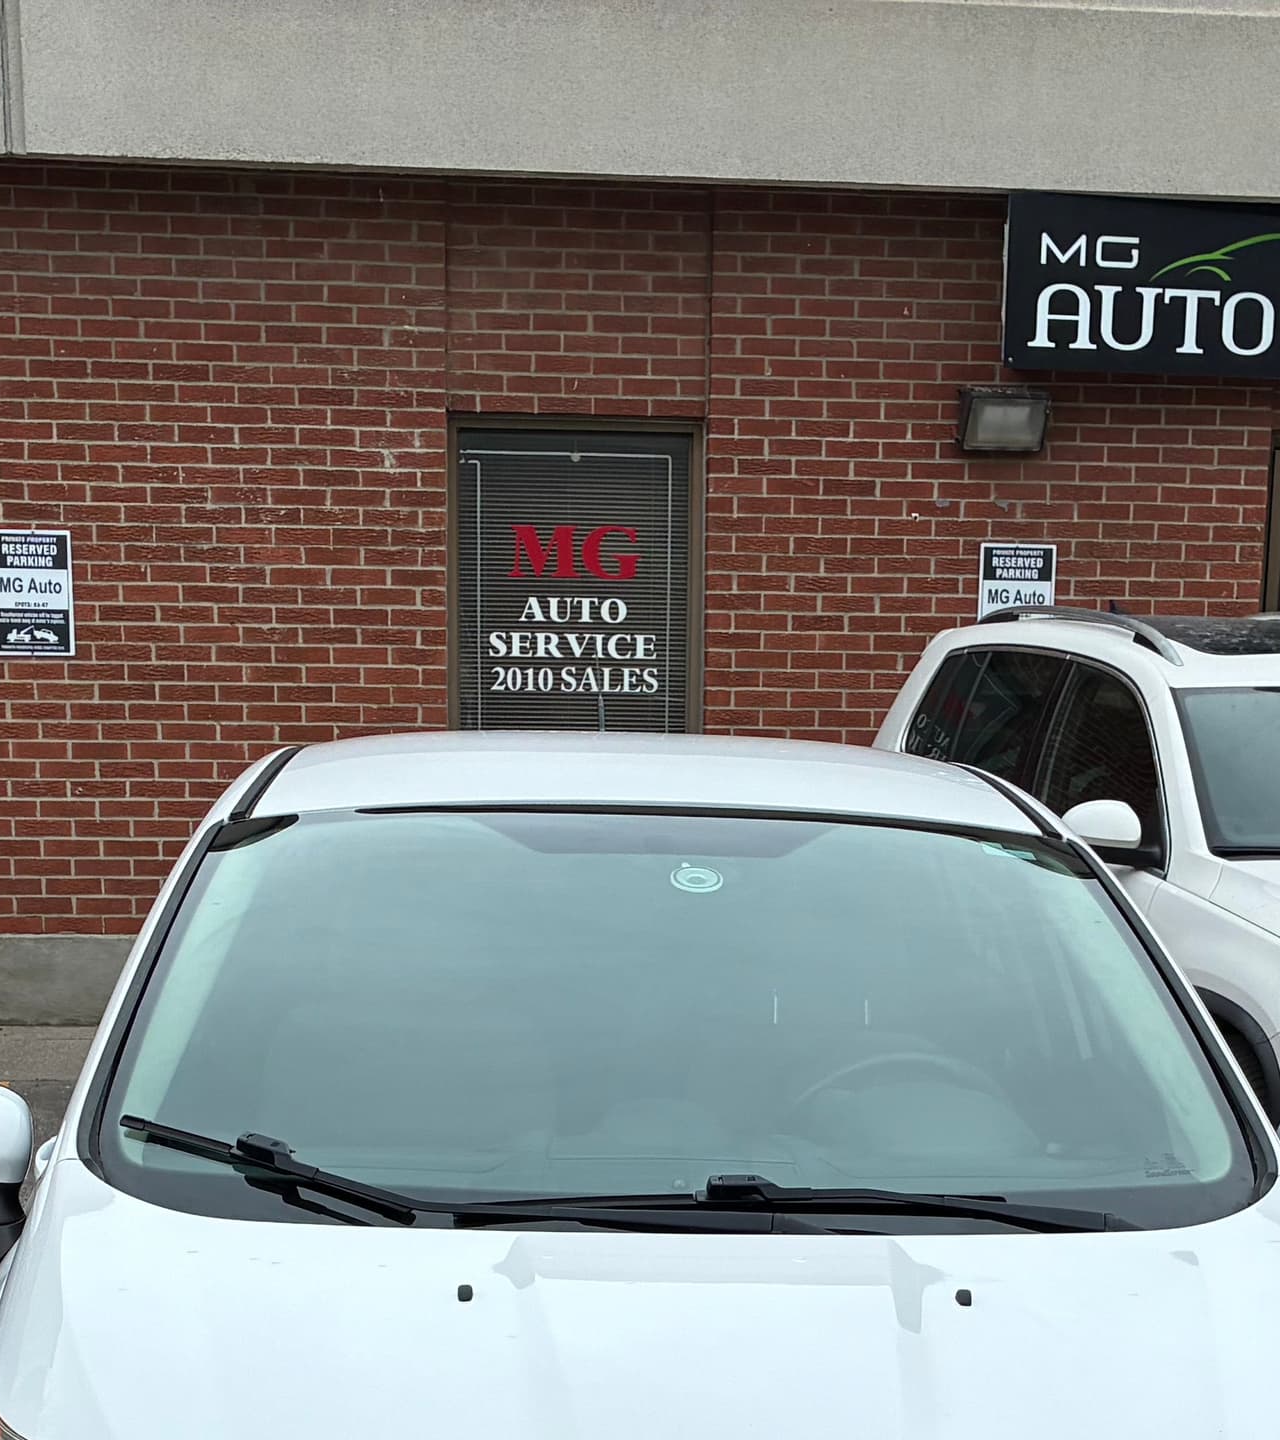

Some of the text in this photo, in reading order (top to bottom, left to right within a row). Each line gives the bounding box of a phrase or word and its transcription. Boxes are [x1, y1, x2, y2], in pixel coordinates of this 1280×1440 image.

[1039, 232, 1141, 269] MG
[1026, 283, 1276, 358] AUTO
[1, 543, 58, 556] RESERVED
[507, 524, 641, 580] MG
[6, 555, 54, 567] PARKING
[991, 556, 1044, 568] RESERVED
[995, 568, 1039, 580] PARKING
[0, 577, 63, 594] MG Auto
[987, 588, 1046, 605] MG Auto
[519, 597, 628, 624] AUTO
[488, 631, 657, 660] SERVICE
[490, 666, 659, 694] 2010 SALES
